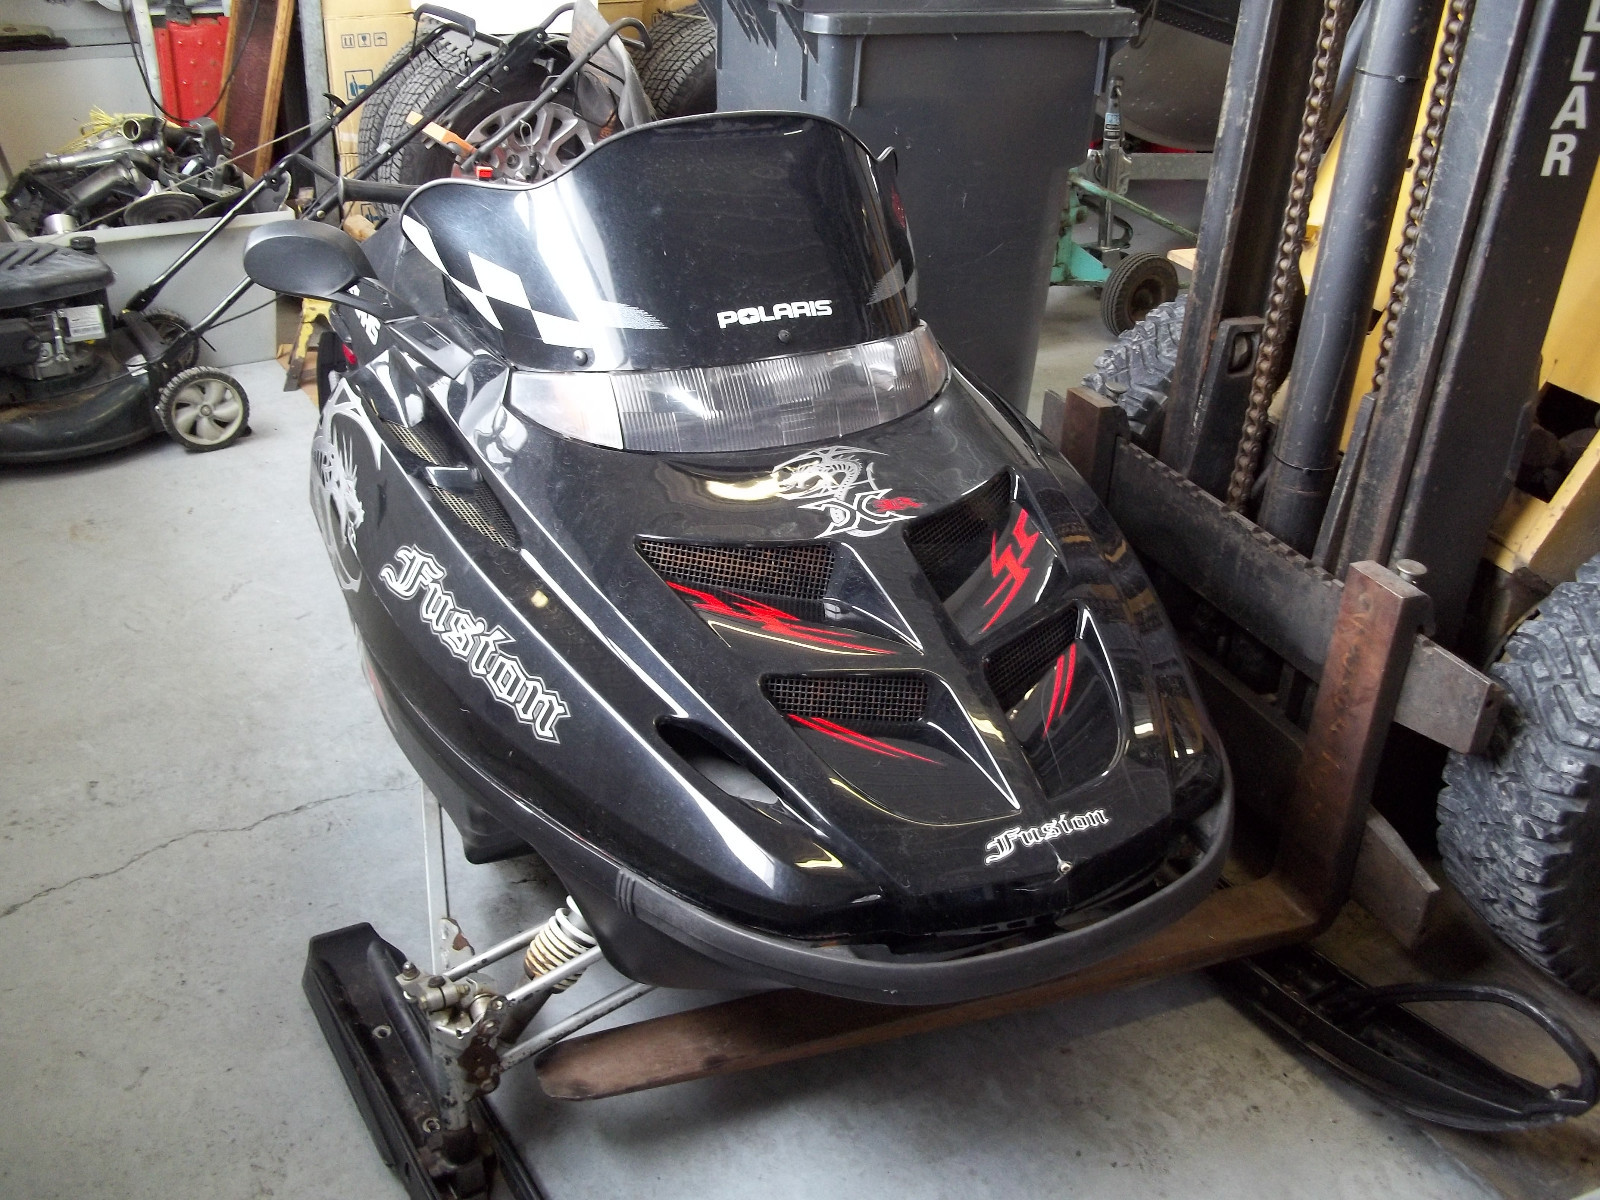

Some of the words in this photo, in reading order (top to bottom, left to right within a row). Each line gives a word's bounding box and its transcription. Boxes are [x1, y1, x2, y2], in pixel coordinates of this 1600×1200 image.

[716, 299, 832, 328] POLARIS
[380, 544, 571, 744] Fusion
[985, 808, 1111, 865] Fusion
